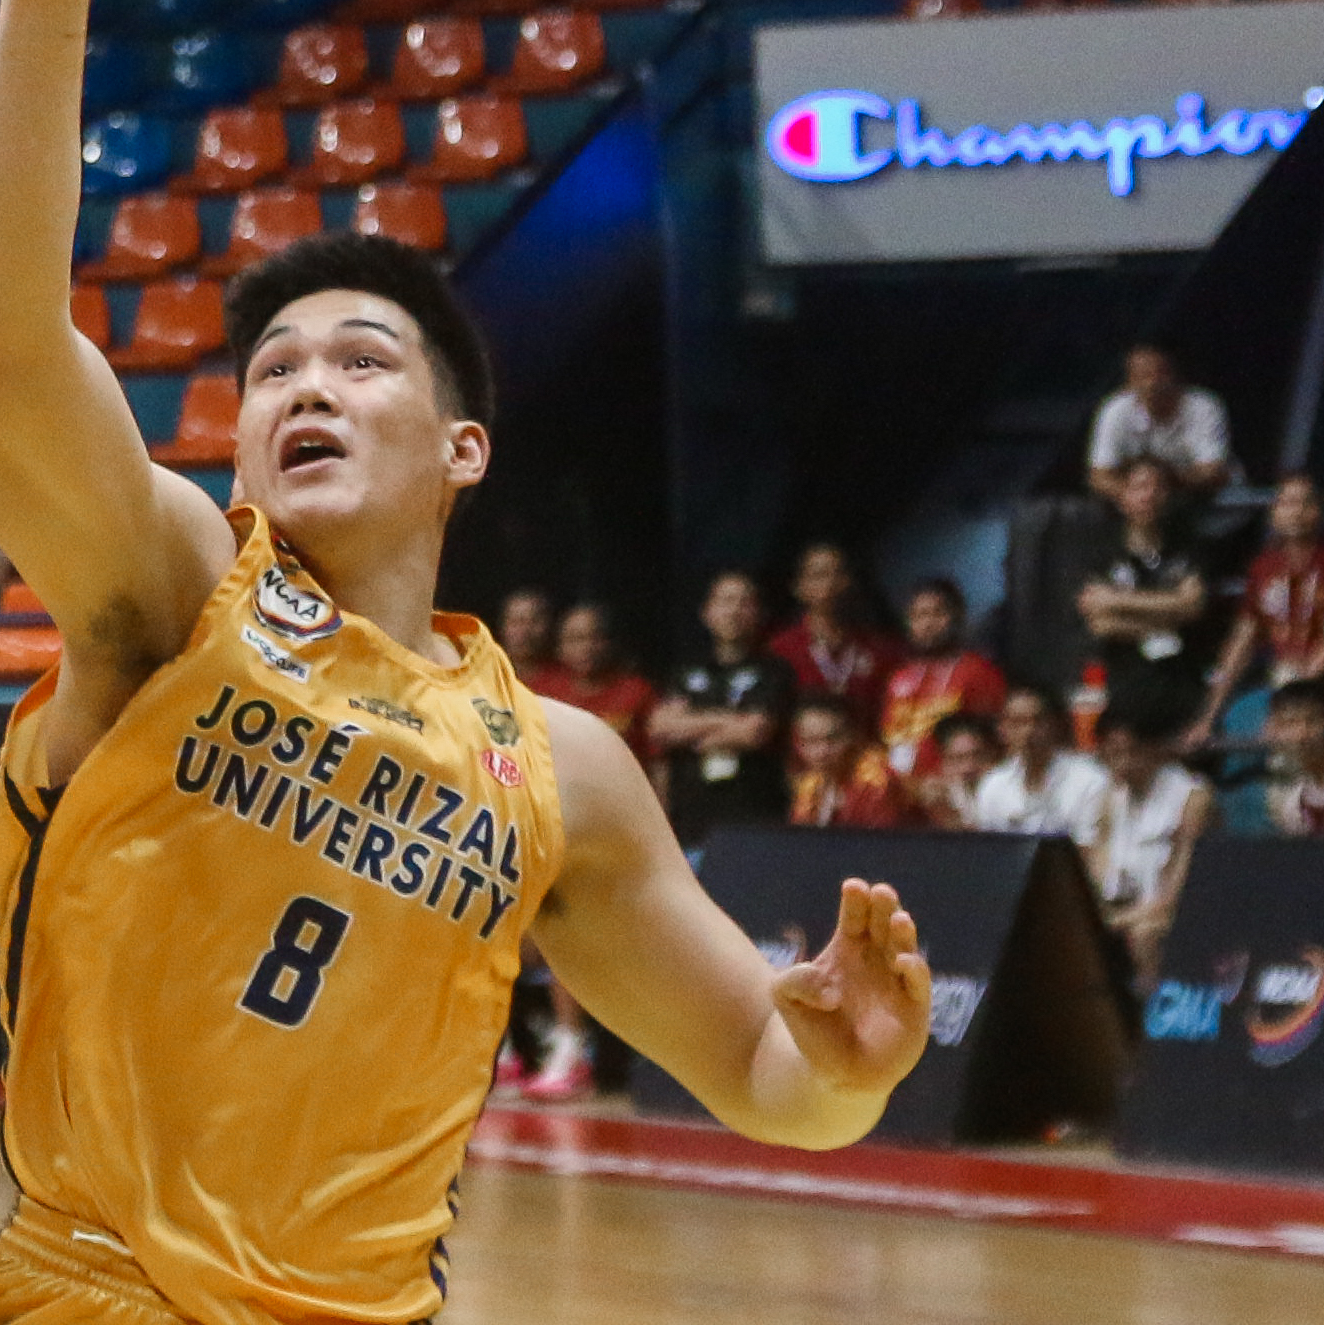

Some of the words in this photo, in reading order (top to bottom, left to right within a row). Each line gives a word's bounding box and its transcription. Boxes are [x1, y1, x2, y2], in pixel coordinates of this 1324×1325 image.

[262, 568, 321, 622] NCAA
[174, 734, 519, 942] UNIVERSITY
[196, 684, 363, 784] JOSÉ
[359, 752, 522, 883] RIZAL
[236, 894, 352, 1031] 8
